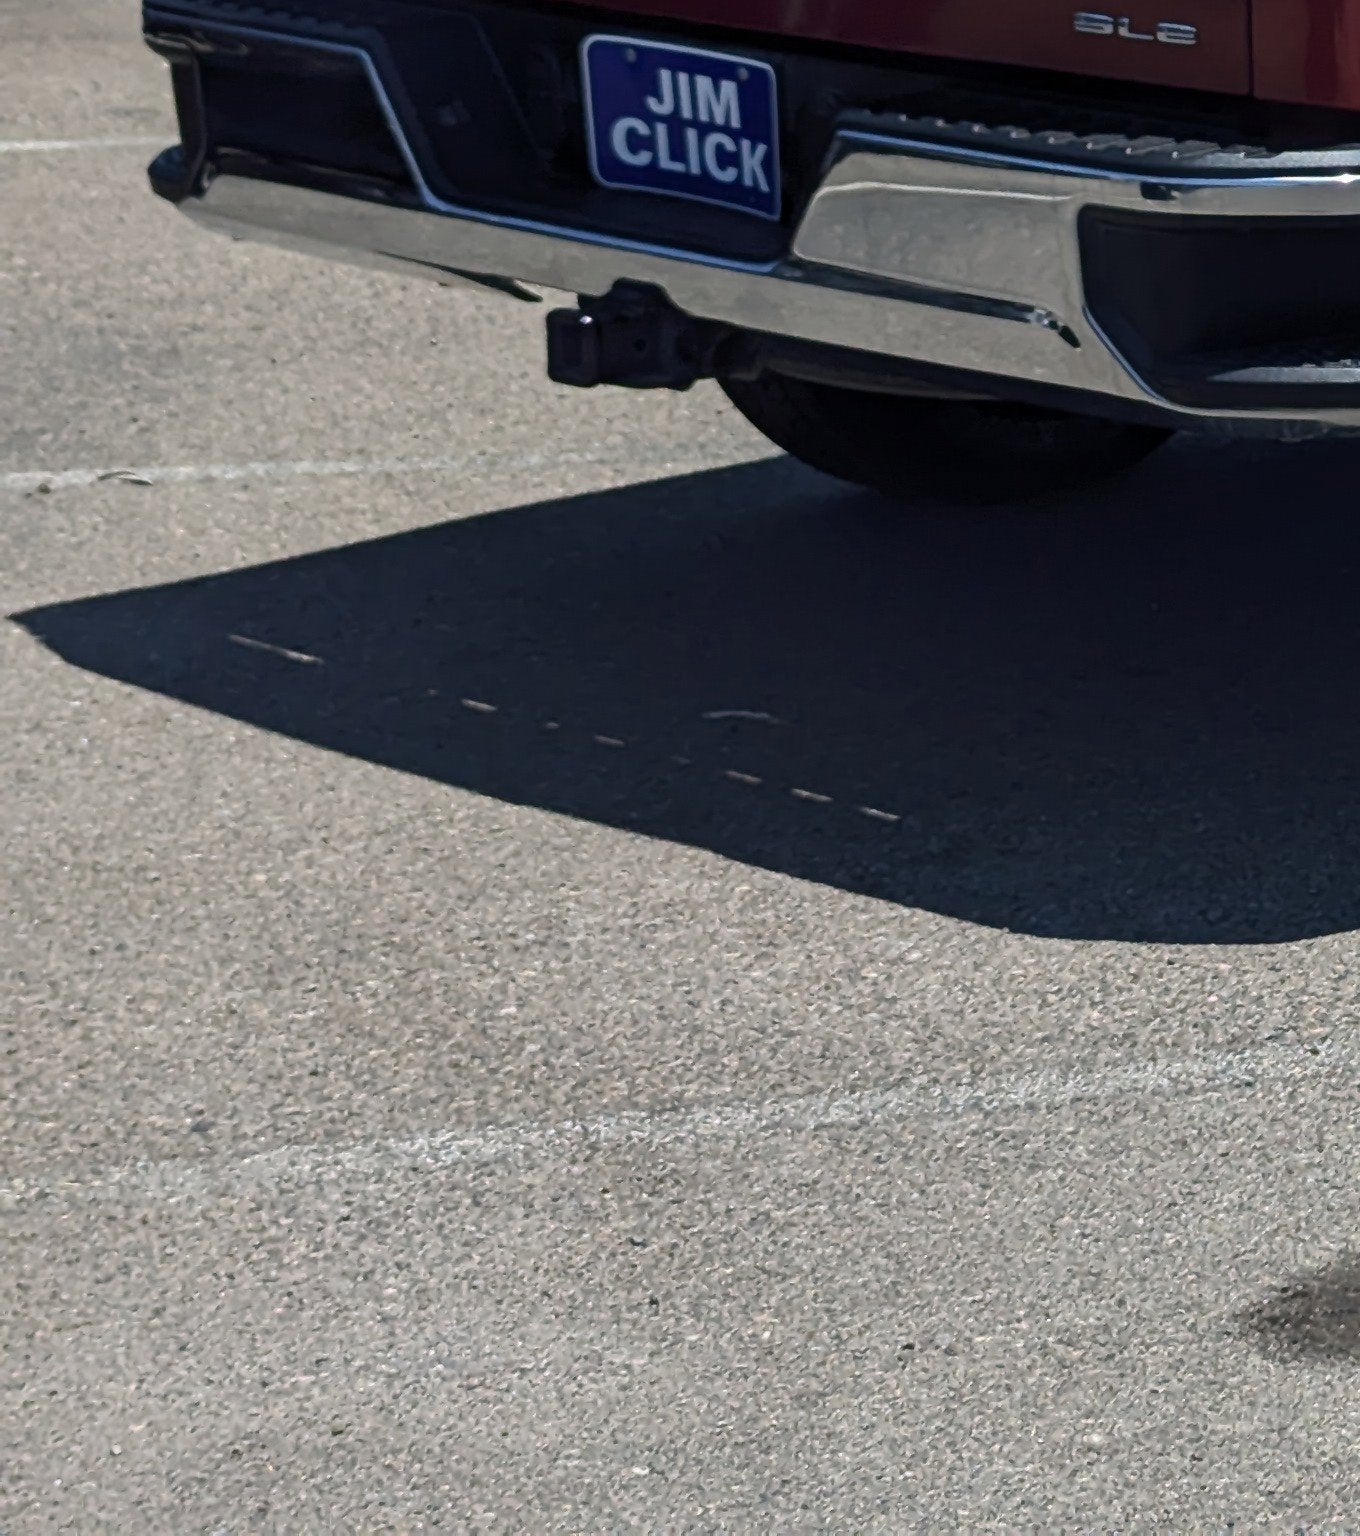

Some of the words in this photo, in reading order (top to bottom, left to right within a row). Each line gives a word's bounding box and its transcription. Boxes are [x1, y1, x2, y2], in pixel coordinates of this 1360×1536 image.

[1074, 11, 1197, 45] SLE
[645, 68, 742, 129] JIM
[611, 116, 771, 193] CLICK
